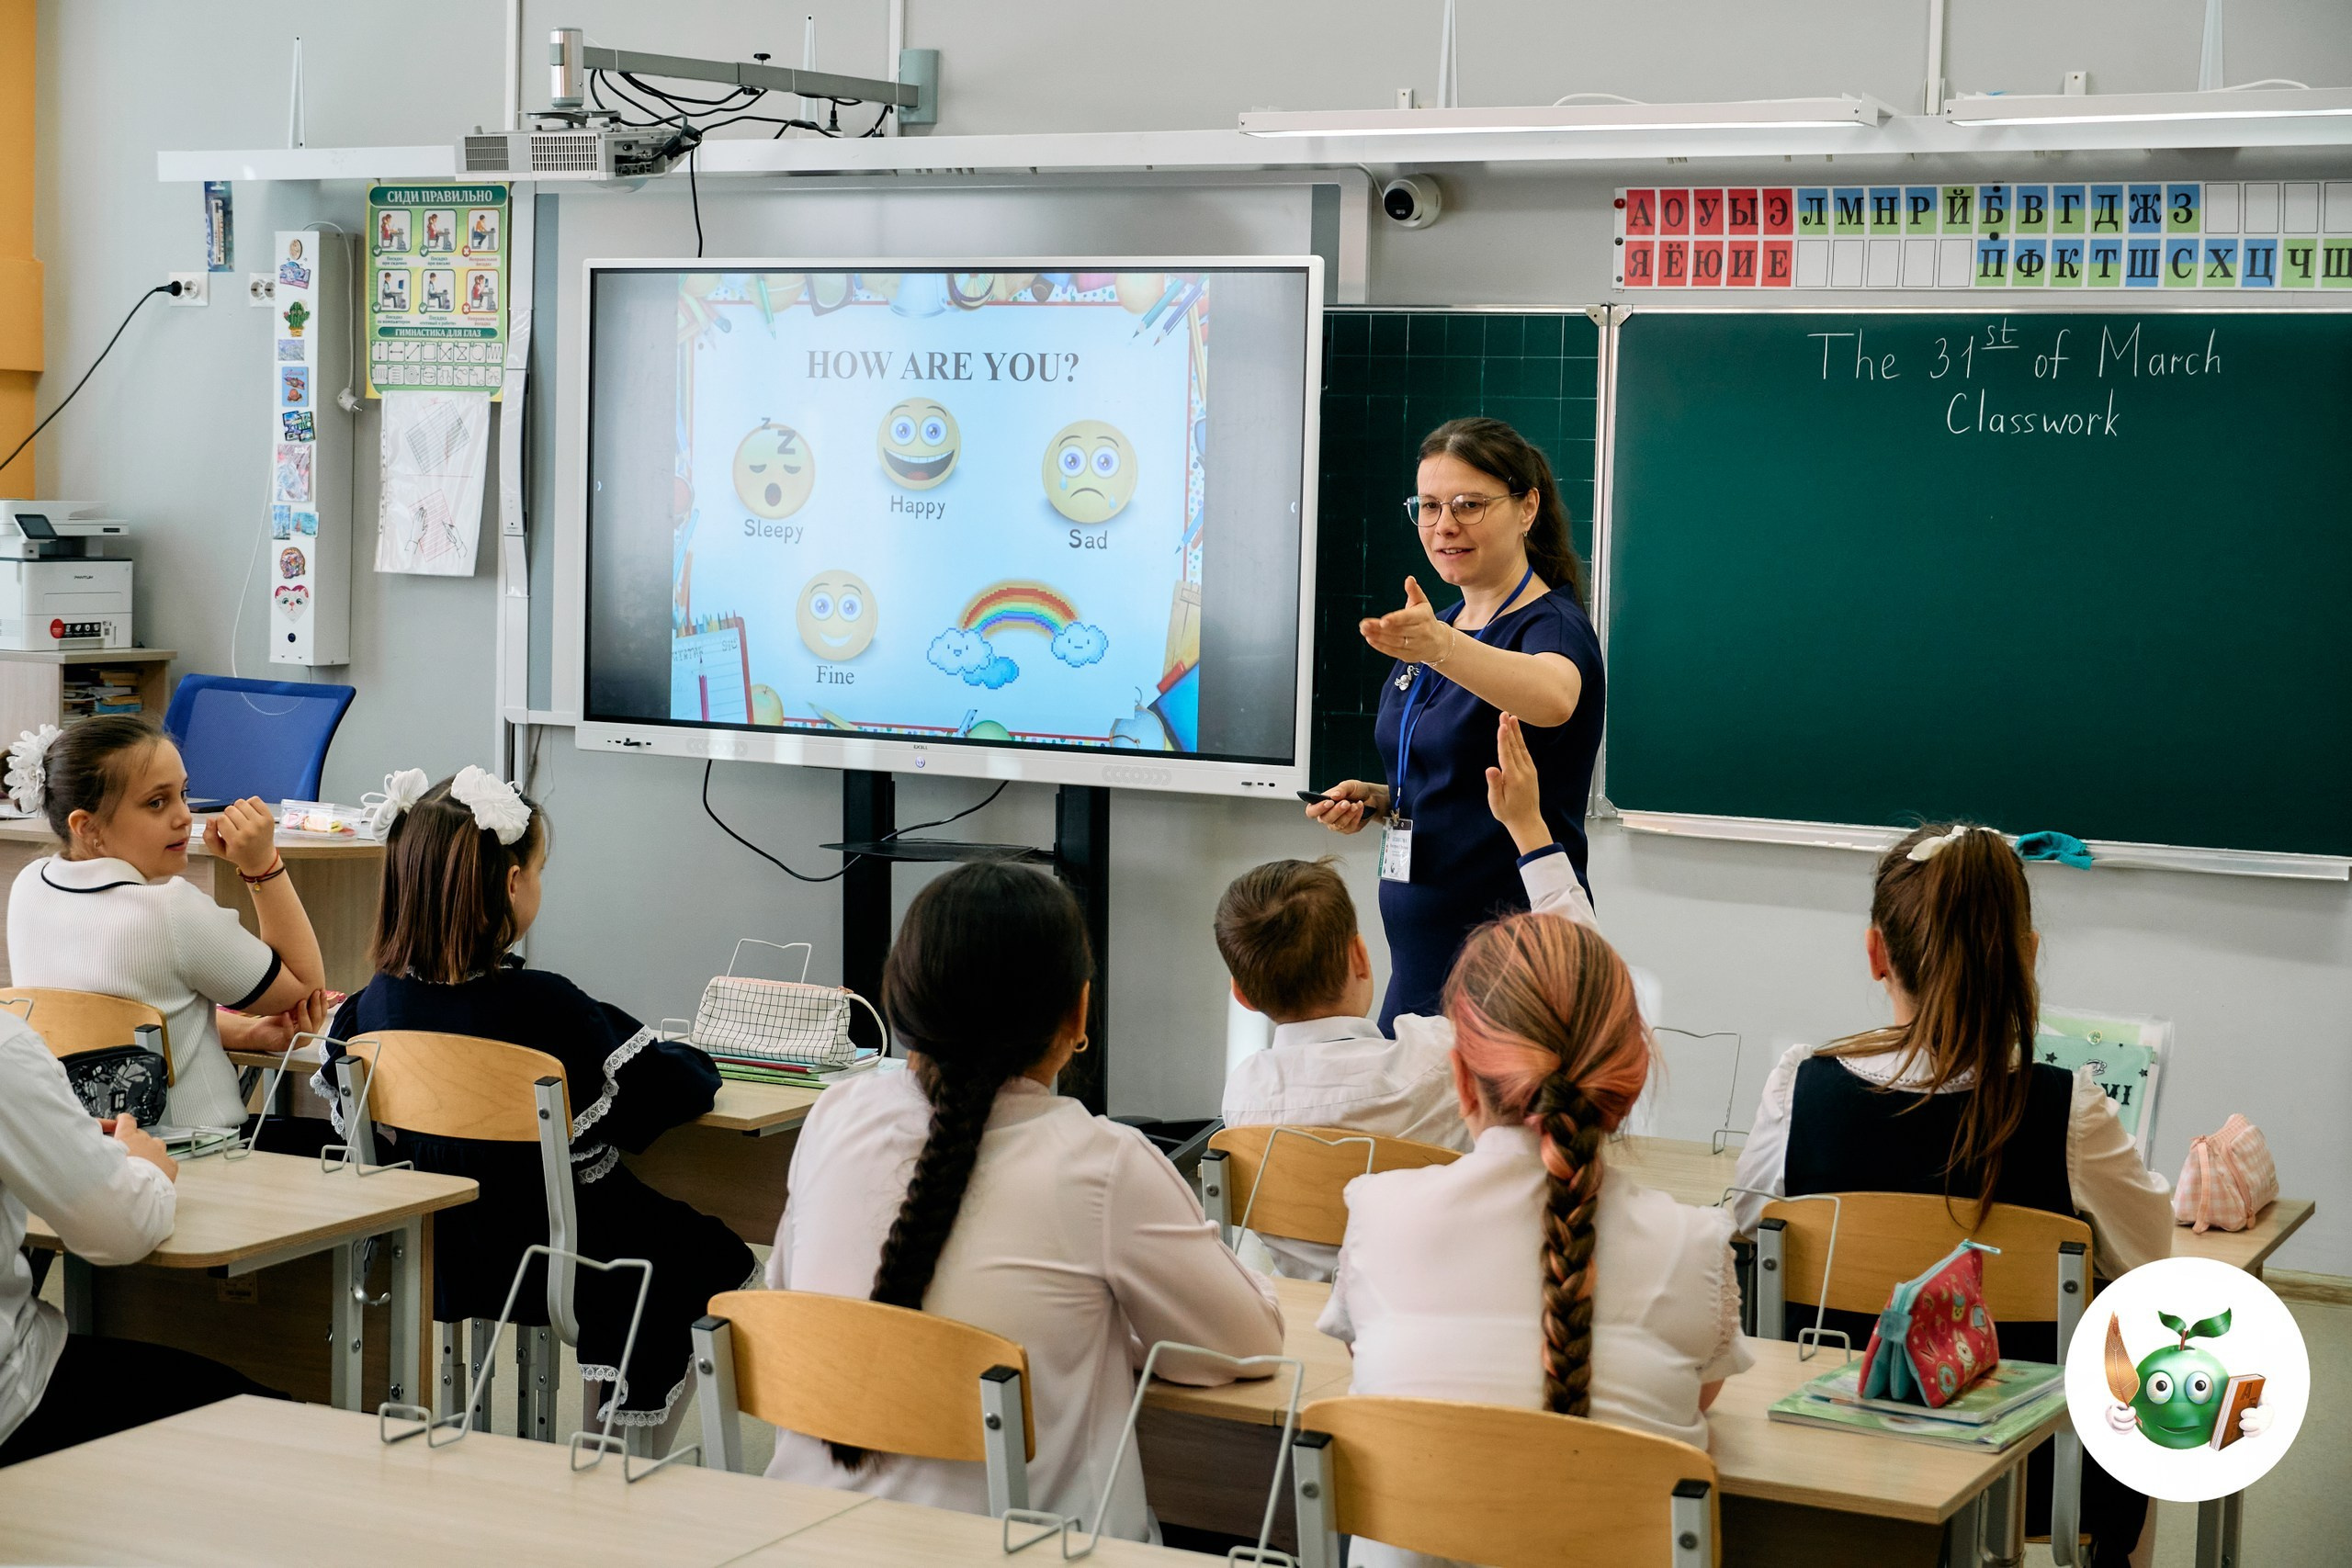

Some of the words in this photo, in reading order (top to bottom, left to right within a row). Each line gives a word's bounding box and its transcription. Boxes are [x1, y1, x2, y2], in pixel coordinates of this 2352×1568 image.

[387, 191, 419, 205] СИДИ
[422, 190, 492, 202] ПРАВИЛЬНО
[1631, 198, 1653, 226] А
[1665, 198, 1683, 226] О
[1698, 197, 1719, 225] У
[1729, 198, 1758, 225] Ы
[1770, 197, 1787, 224] Э
[1803, 197, 1826, 225] Л
[1838, 197, 1864, 224] М
[1874, 197, 1897, 224] Н
[1910, 197, 1929, 224] Р
[1947, 189, 1971, 223] Й
[1983, 196, 2003, 223] Б
[2022, 196, 2042, 223] В
[2061, 195, 2079, 223] Г
[2095, 195, 2118, 231] Д
[2130, 194, 2161, 223] Ж
[2174, 194, 2192, 223] З
[1629, 250, 1649, 277] Я
[1664, 243, 1683, 277] Ё
[1693, 250, 1722, 277] Ю
[1733, 250, 1754, 277] И
[1769, 250, 1787, 277] Е
[1980, 250, 2006, 276] П
[2017, 250, 2043, 277] Ф
[2055, 249, 2078, 278] К
[2096, 250, 2116, 277] Т
[2128, 249, 2160, 277] Ш
[2172, 248, 2191, 278] С
[2208, 249, 2233, 277] Х
[2246, 249, 2274, 285] Ц
[2288, 249, 2312, 277] Ч
[395, 329, 446, 337] ГИМНАСТИКА
[447, 329, 461, 338] ДЛЯ
[463, 329, 481, 337] ГЛАЗ
[1807, 328, 1901, 380] The
[2035, 329, 2070, 379] of
[2098, 321, 2222, 378] March
[806, 350, 893, 379] HOW
[899, 351, 973, 380] ARE
[982, 352, 1080, 382] YOU?
[1946, 388, 2120, 436] Classwork
[890, 495, 945, 519] Happy
[744, 519, 803, 544] Sleepy
[1069, 528, 1108, 549] Sad
[816, 665, 854, 684] Fine
